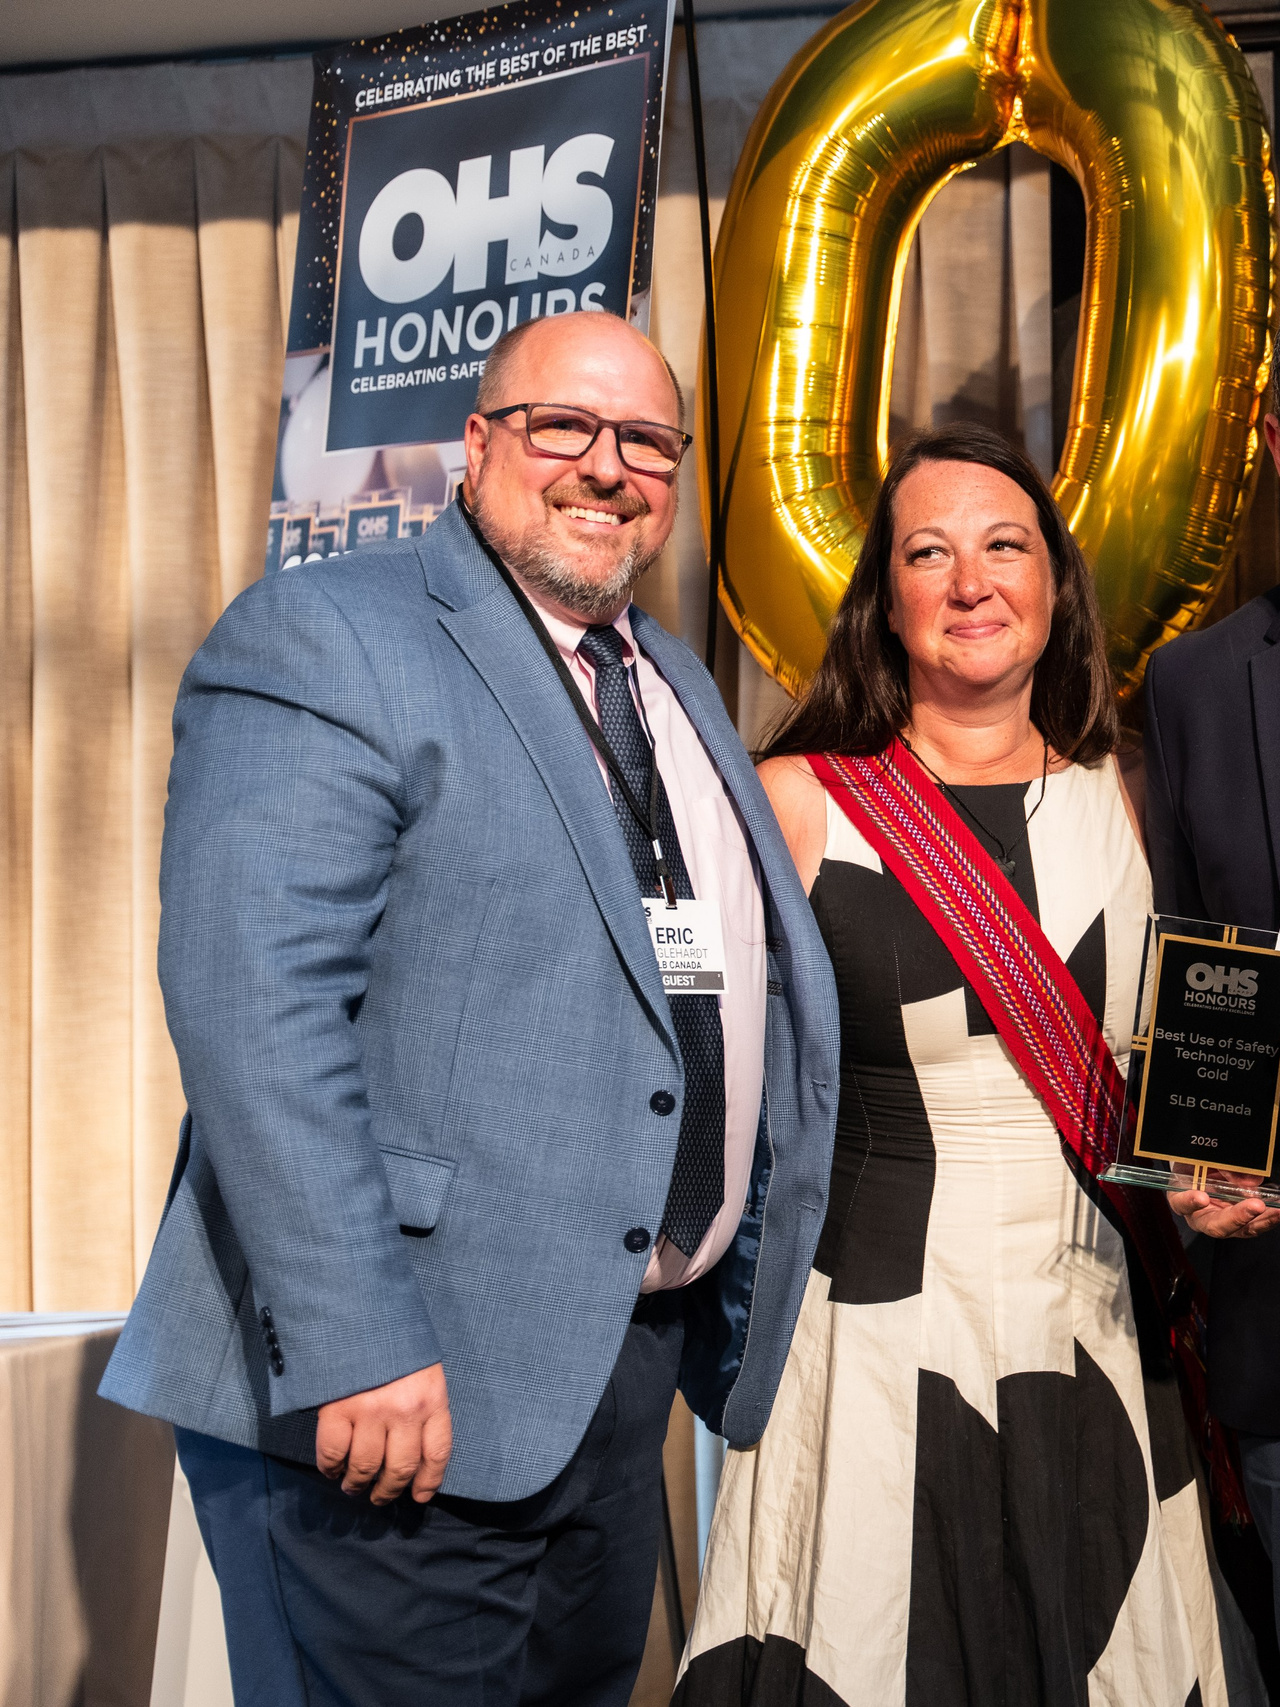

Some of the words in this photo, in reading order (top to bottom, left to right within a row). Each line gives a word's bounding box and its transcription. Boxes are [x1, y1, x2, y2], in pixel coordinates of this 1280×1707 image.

[355, 69, 462, 108] CELEBRATING
[465, 61, 497, 83] THE
[500, 51, 540, 76] BEST
[543, 45, 567, 66] OF
[570, 35, 601, 59] THE
[605, 24, 648, 51] BEST
[358, 133, 615, 304] OHS
[509, 245, 595, 272] CANADA
[350, 365, 447, 394] CELEBRATING
[450, 360, 487, 380] SAFE
[655, 927, 694, 945] ERIC
[656, 947, 708, 959] GLEHARDT
[658, 960, 667, 969] LB
[669, 961, 702, 969] CANADA
[662, 974, 696, 986] GUEST
[1185, 962, 1259, 997] OHS
[1183, 1001, 1212, 1010] CELEBRATING
[1228, 1008, 1255, 1016] EXCELLENCE
[1184, 990, 1256, 1010] HONOURS
[1155, 1028, 1186, 1043] Best
[1189, 1032, 1215, 1046] Use
[1218, 1038, 1234, 1049] of
[1235, 1039, 1279, 1058] Safety
[1174, 1046, 1255, 1071] Technology
[1196, 1067, 1229, 1081] Gold
[1169, 1094, 1196, 1108] SLB
[1200, 1099, 1252, 1116] Canada
[1190, 1135, 1219, 1148] 2026
